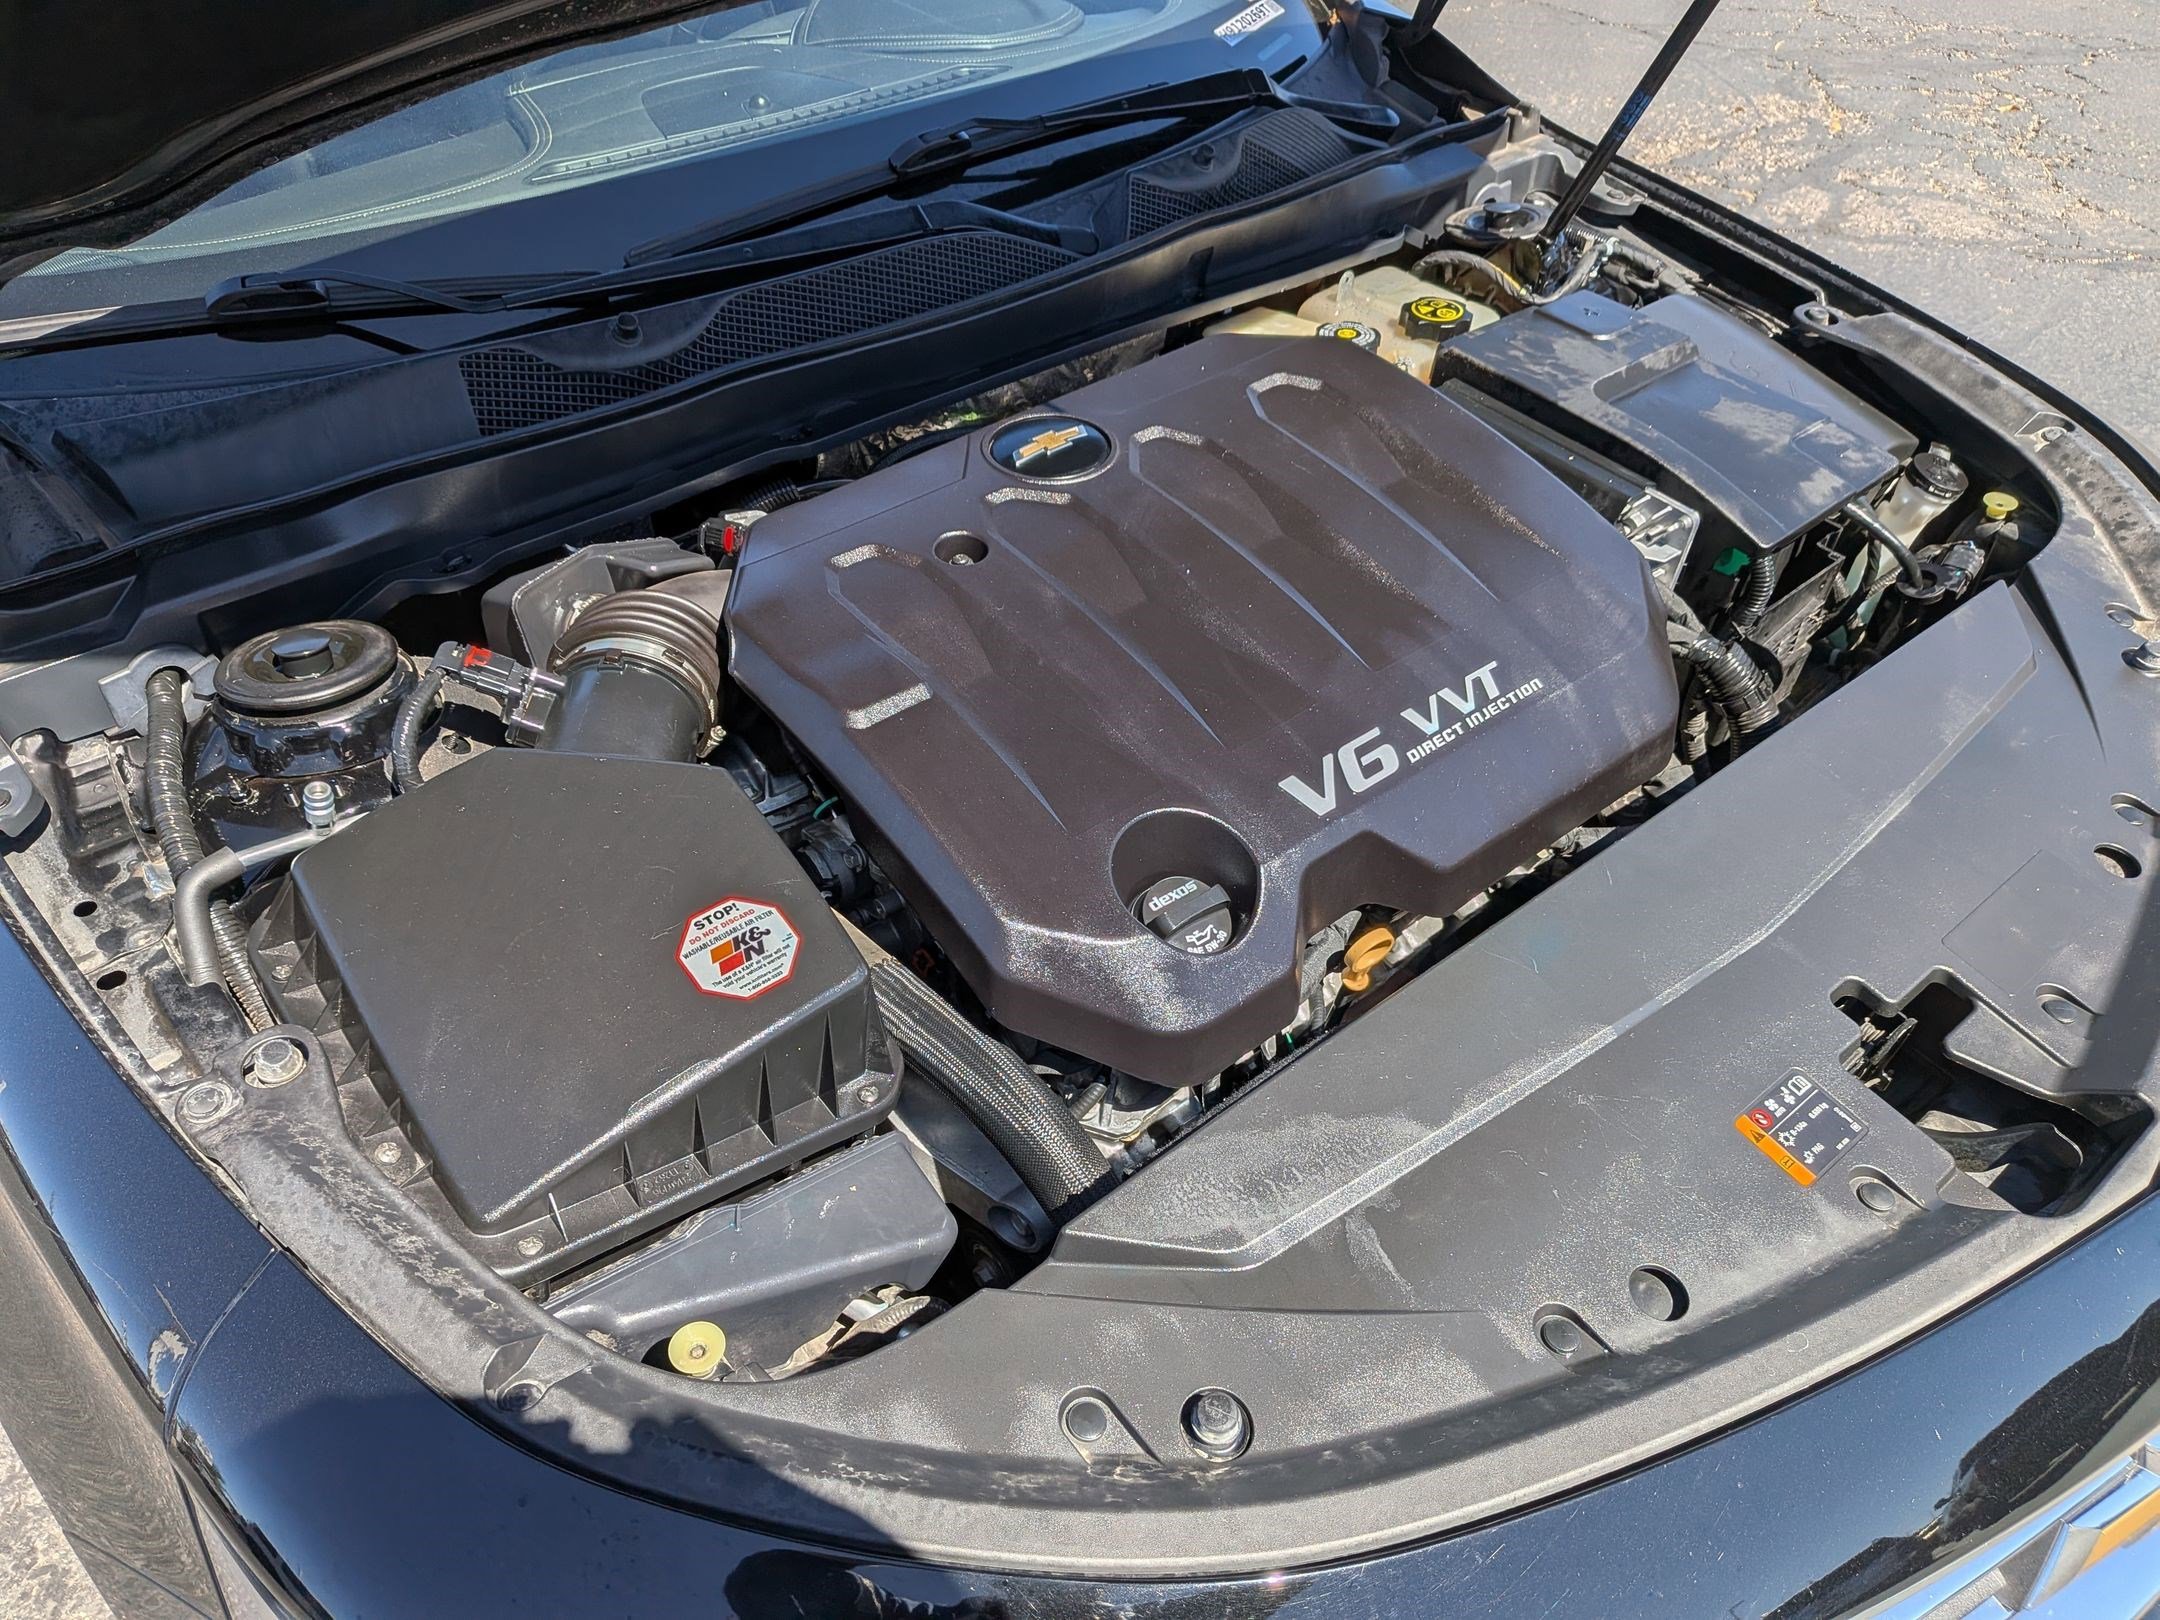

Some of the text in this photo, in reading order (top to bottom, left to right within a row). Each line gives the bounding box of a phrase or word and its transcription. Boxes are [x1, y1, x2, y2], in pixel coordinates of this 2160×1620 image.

[1278, 660, 1500, 816] V6 VVT
[1405, 678, 1544, 764] DIRECT INJECTION
[1148, 880, 1198, 911] dexos
[682, 910, 775, 960] WASHABLE/REUSABLE AIR FILTER
[688, 908, 756, 946] DO NOT DISCARD
[693, 902, 740, 931] STOP!
[1205, 930, 1228, 954] 5W-30
[711, 979, 723, 988] The
[722, 974, 732, 984] use
[782, 943, 791, 953] not
